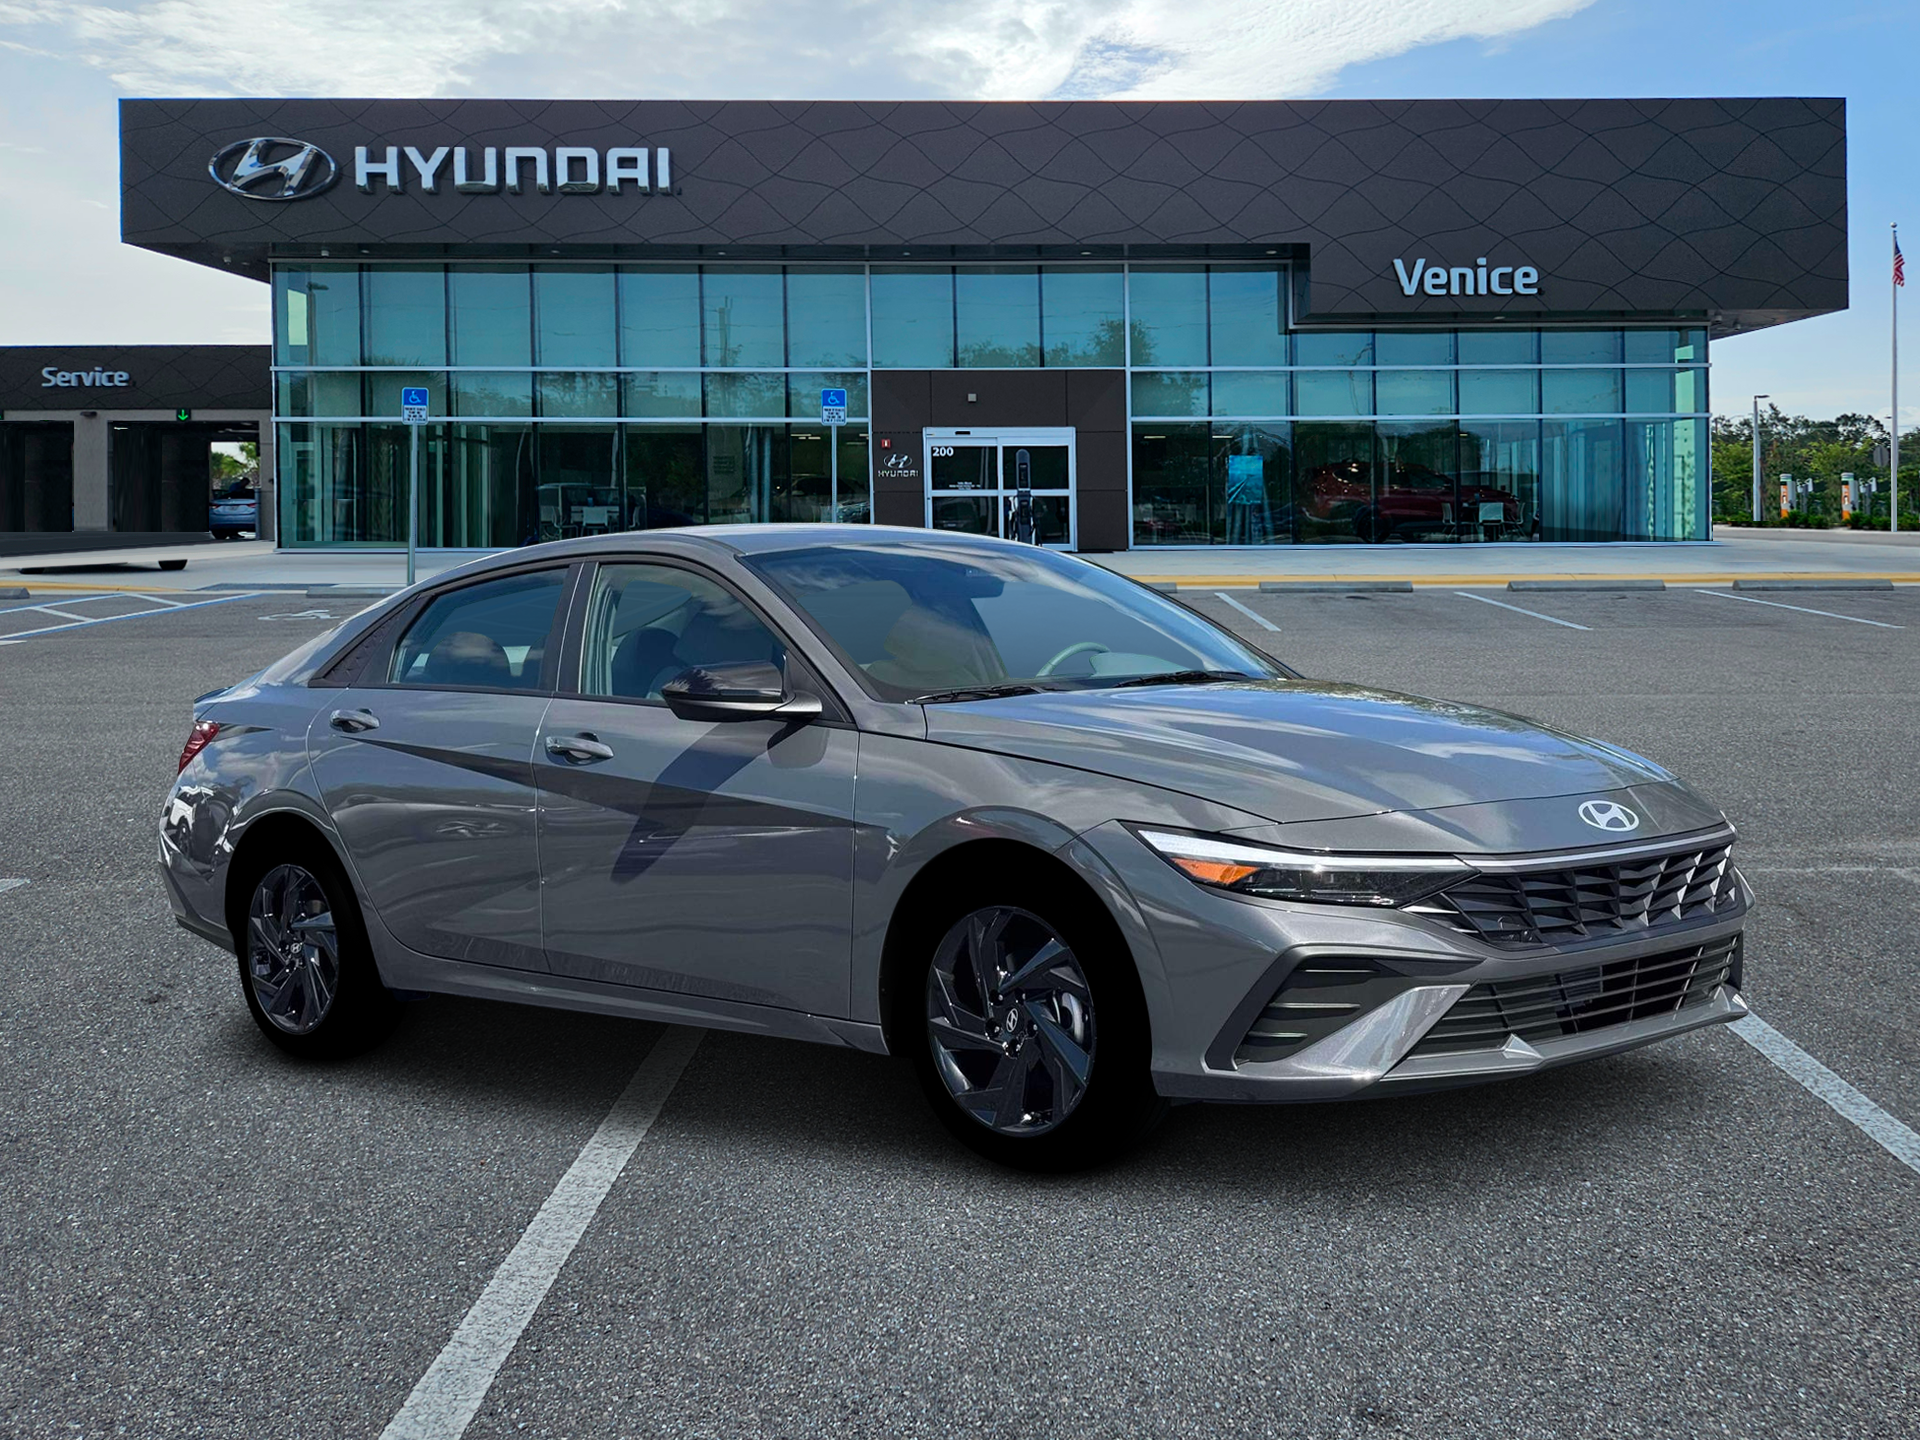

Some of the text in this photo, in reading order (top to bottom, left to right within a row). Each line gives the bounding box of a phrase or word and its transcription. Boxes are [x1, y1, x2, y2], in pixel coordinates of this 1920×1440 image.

[354, 147, 672, 193] HYUNDAI
[1394, 257, 1538, 296] Venice
[41, 366, 130, 387] Service
[932, 447, 953, 457] 200
